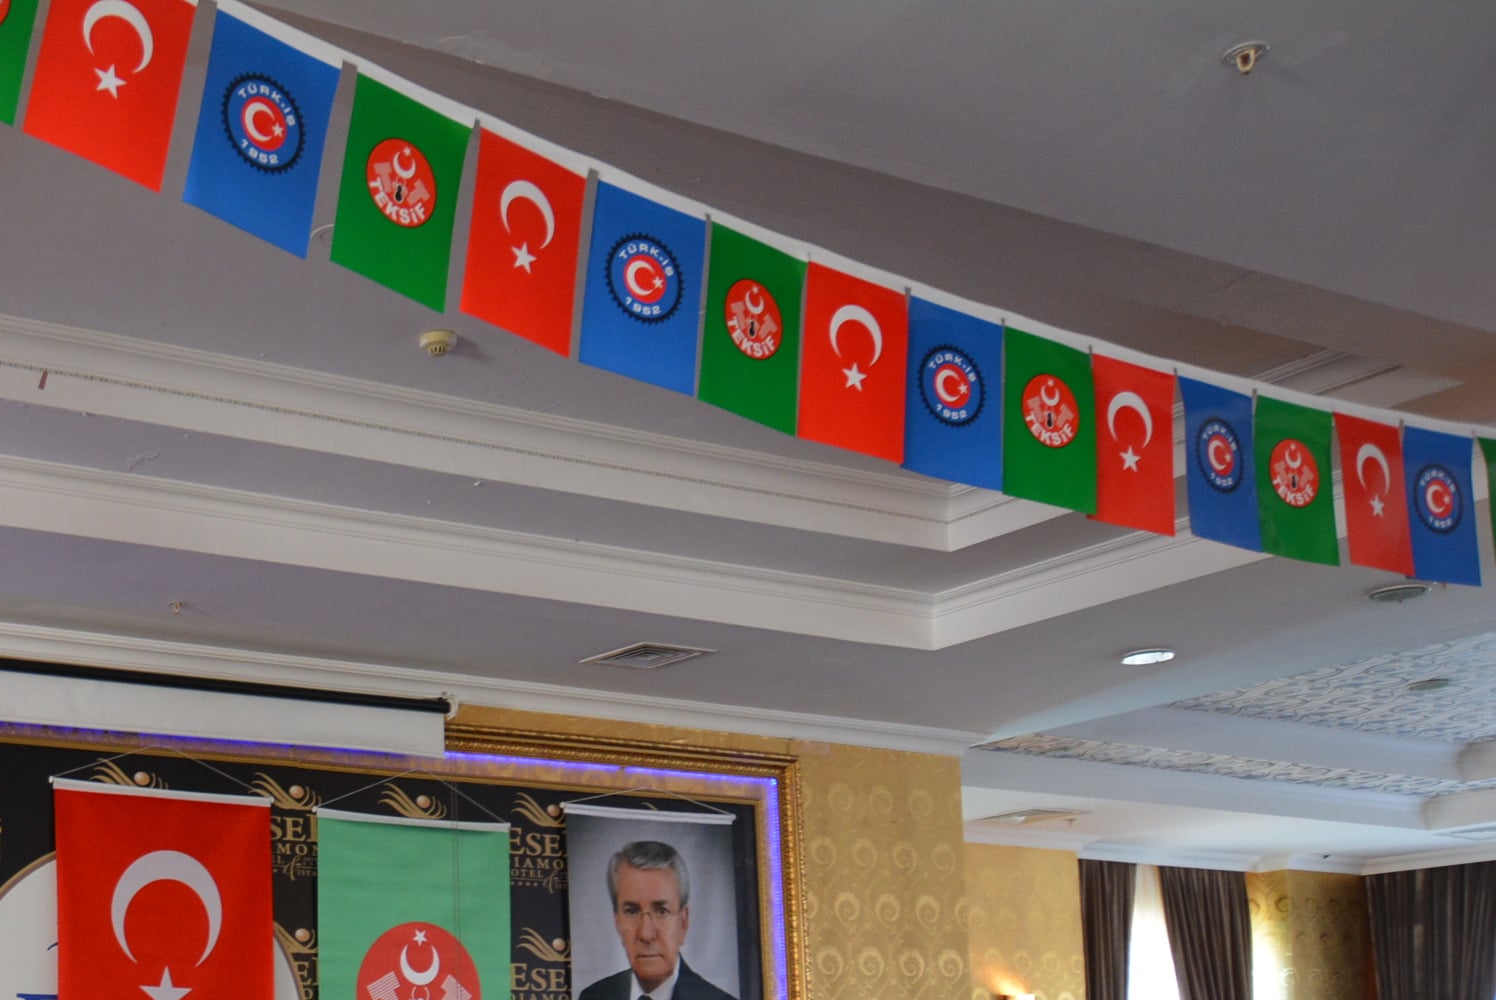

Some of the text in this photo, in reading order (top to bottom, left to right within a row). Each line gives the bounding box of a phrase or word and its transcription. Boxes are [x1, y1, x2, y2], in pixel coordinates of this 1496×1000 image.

[240, 139, 279, 164] 1952
[625, 297, 661, 315] 1952
[509, 827, 566, 856] ESE
[511, 869, 544, 878] OTEL
[514, 857, 564, 870] IAMO
[511, 963, 568, 992] ESE
